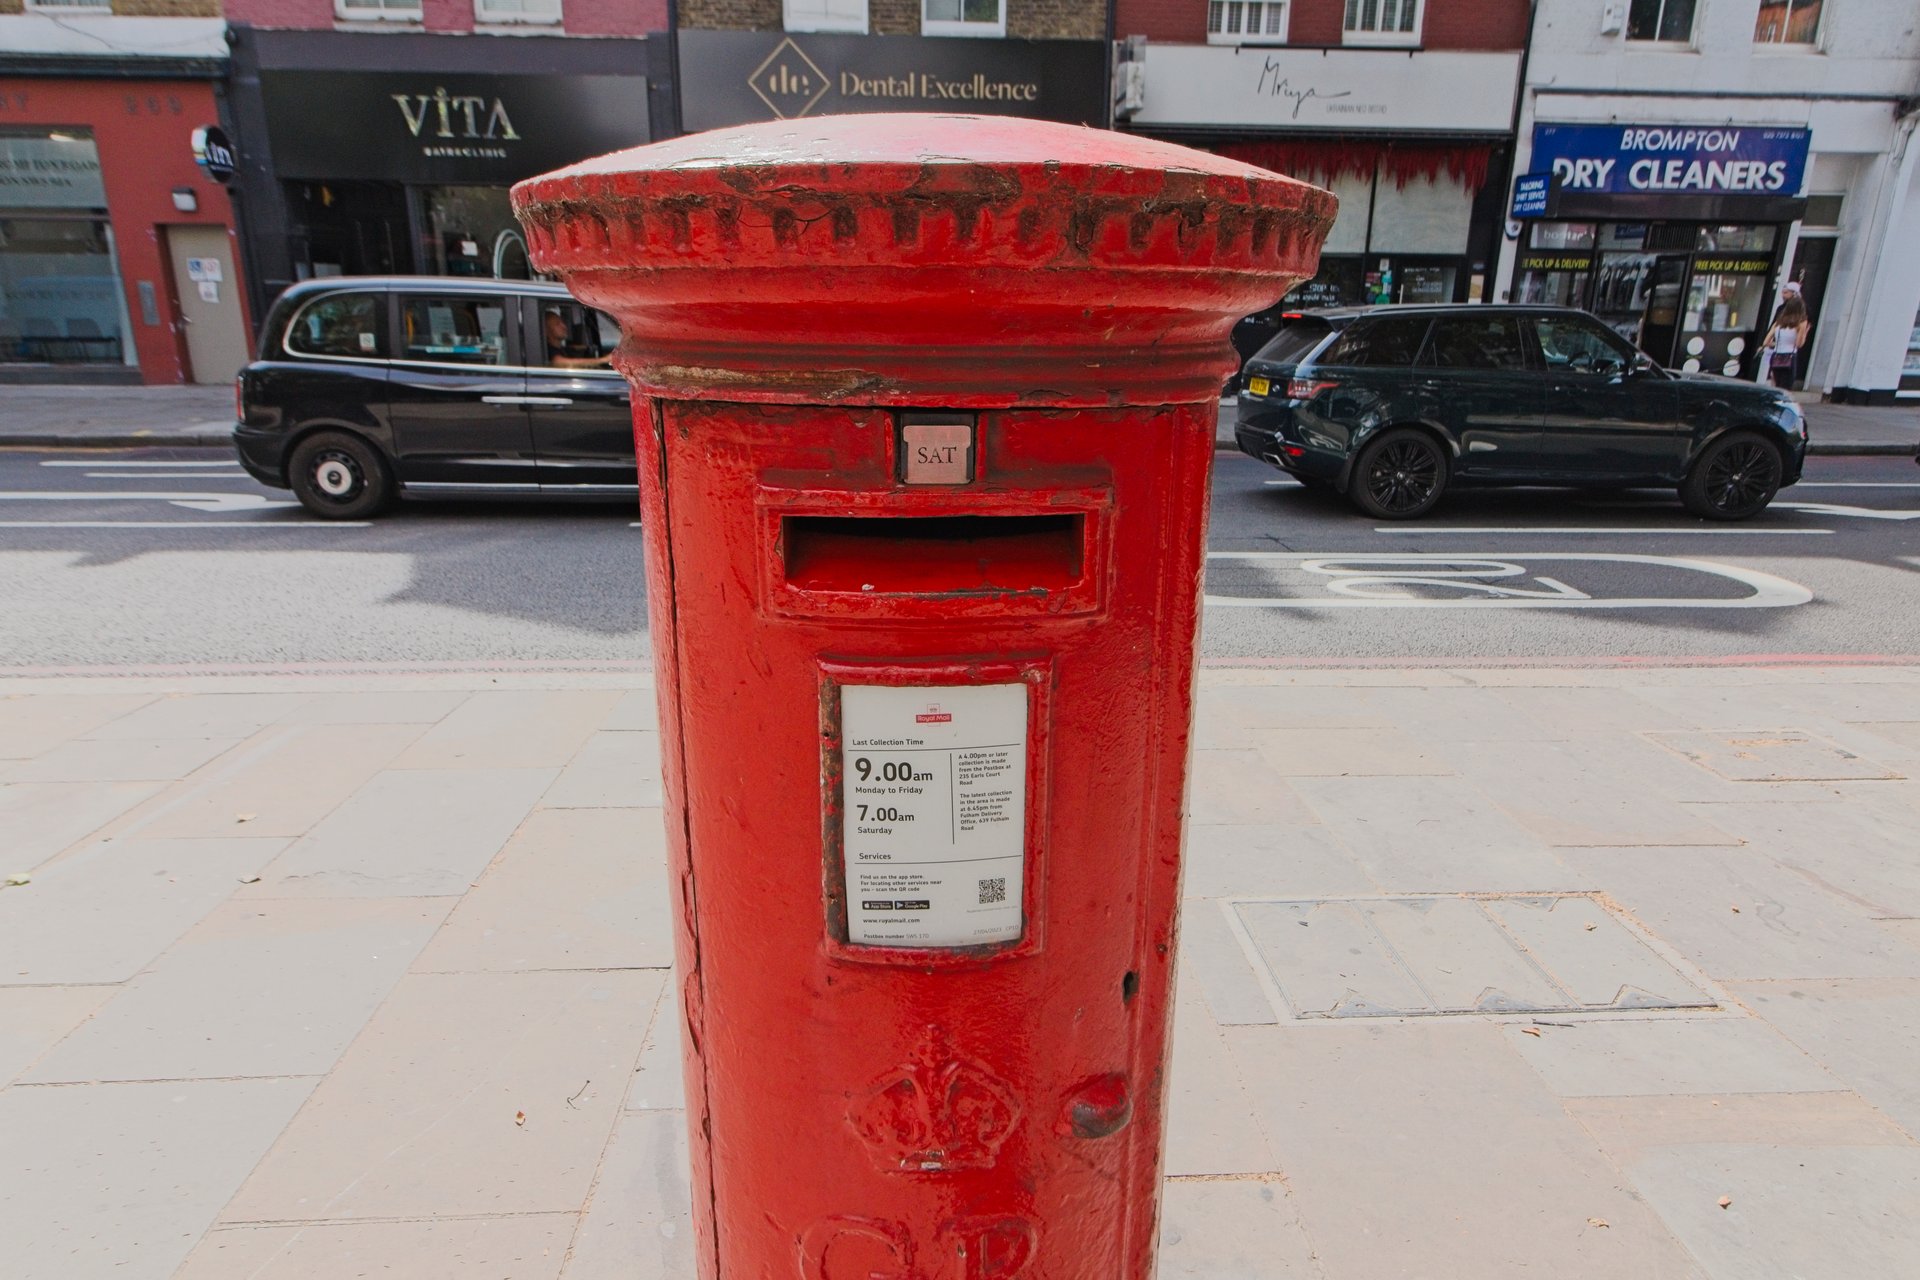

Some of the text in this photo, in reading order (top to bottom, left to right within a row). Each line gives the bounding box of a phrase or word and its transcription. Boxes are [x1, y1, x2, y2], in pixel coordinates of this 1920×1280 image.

[840, 72, 1038, 100] Dental Excellence
[1258, 55, 1351, 120] Mriya
[1620, 129, 1740, 152] BROMPTON
[1553, 158, 1787, 191] DRY CLEANERS
[1709, 260, 1724, 270] PICK
[1724, 261, 1734, 270] UP
[1740, 261, 1770, 271] DELIVERY
[918, 447, 957, 464] SAT
[918, 714, 935, 722] Royal
[856, 787, 886, 795] Monday
[858, 827, 892, 835] Saturday
